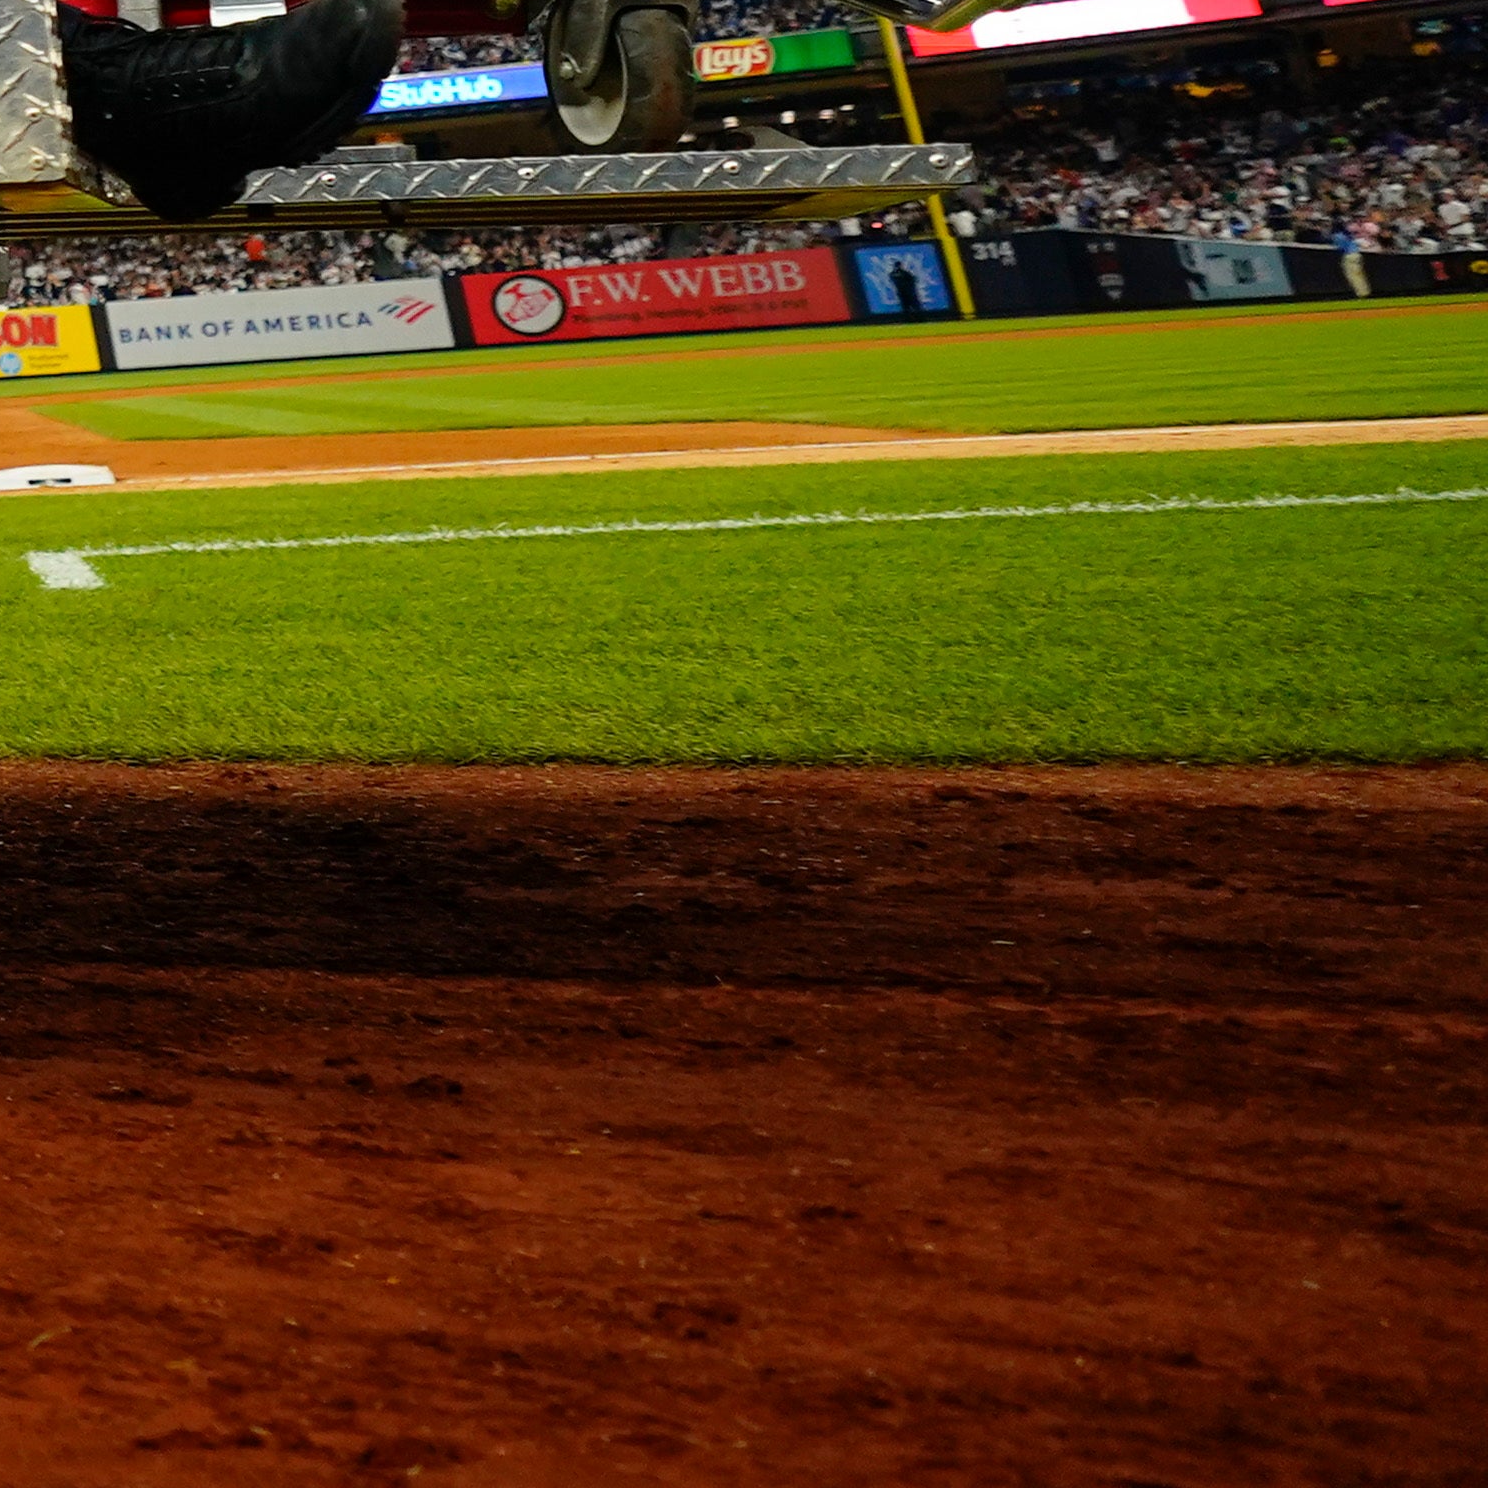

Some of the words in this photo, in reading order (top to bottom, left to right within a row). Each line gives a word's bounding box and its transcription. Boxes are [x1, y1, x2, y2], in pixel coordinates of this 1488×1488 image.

[379, 74, 503, 109] StubHub
[565, 270, 651, 307] F.W.
[657, 260, 807, 299] WEBB
[120, 323, 192, 344] BANK
[201, 319, 233, 338] OF
[243, 311, 374, 335] AMERICA
